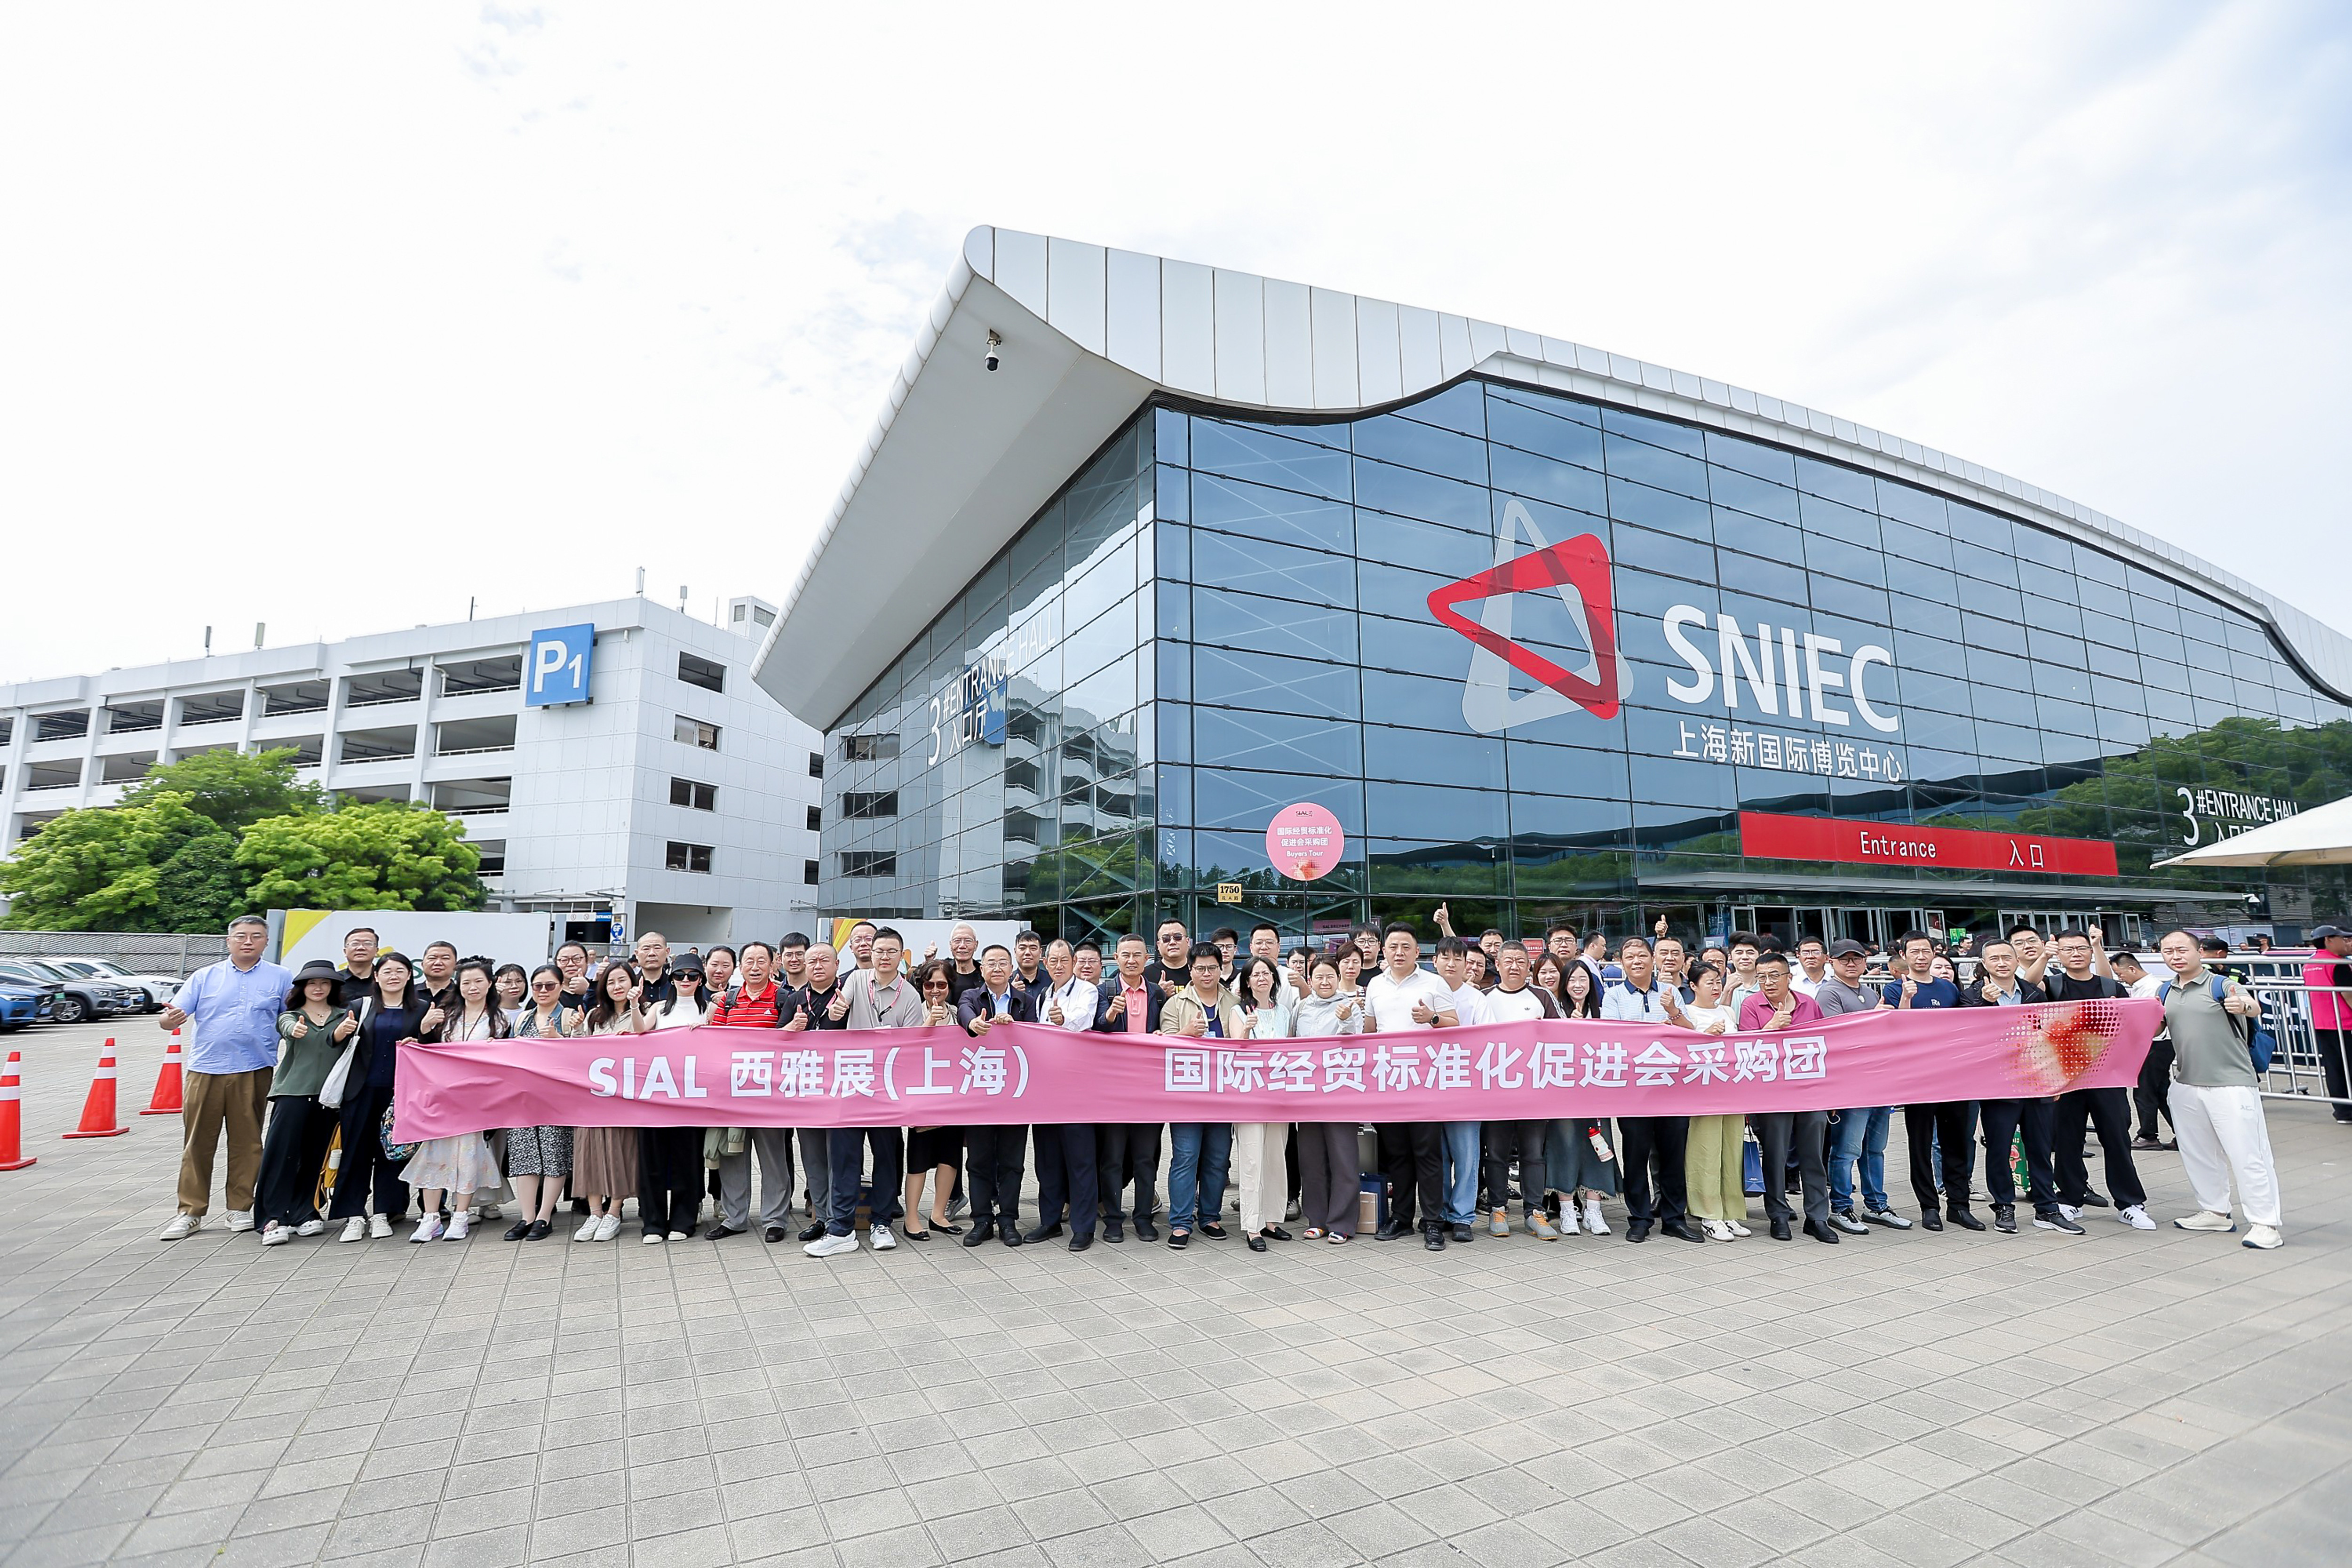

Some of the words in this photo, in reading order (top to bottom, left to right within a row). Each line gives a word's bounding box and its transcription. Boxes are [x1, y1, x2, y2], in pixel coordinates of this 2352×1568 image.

[533, 640, 583, 692] P1
[928, 697, 940, 766] 3
[1018, 608, 1056, 667] HALL
[1663, 605, 1899, 732] SNIEC
[949, 698, 987, 756] 入口厅
[1673, 720, 1902, 782] 上海新国际博览中心
[1281, 837, 1328, 847] 促进会采购团
[1860, 832, 1936, 858] Entrance
[2177, 787, 2199, 845] 3
[2009, 840, 2043, 868] 入口
[588, 1055, 707, 1099] SIAL
[731, 1046, 1028, 1100] 西雅展(上海)
[1165, 1035, 1827, 1093] 国际经贸标准化促进会采购团
